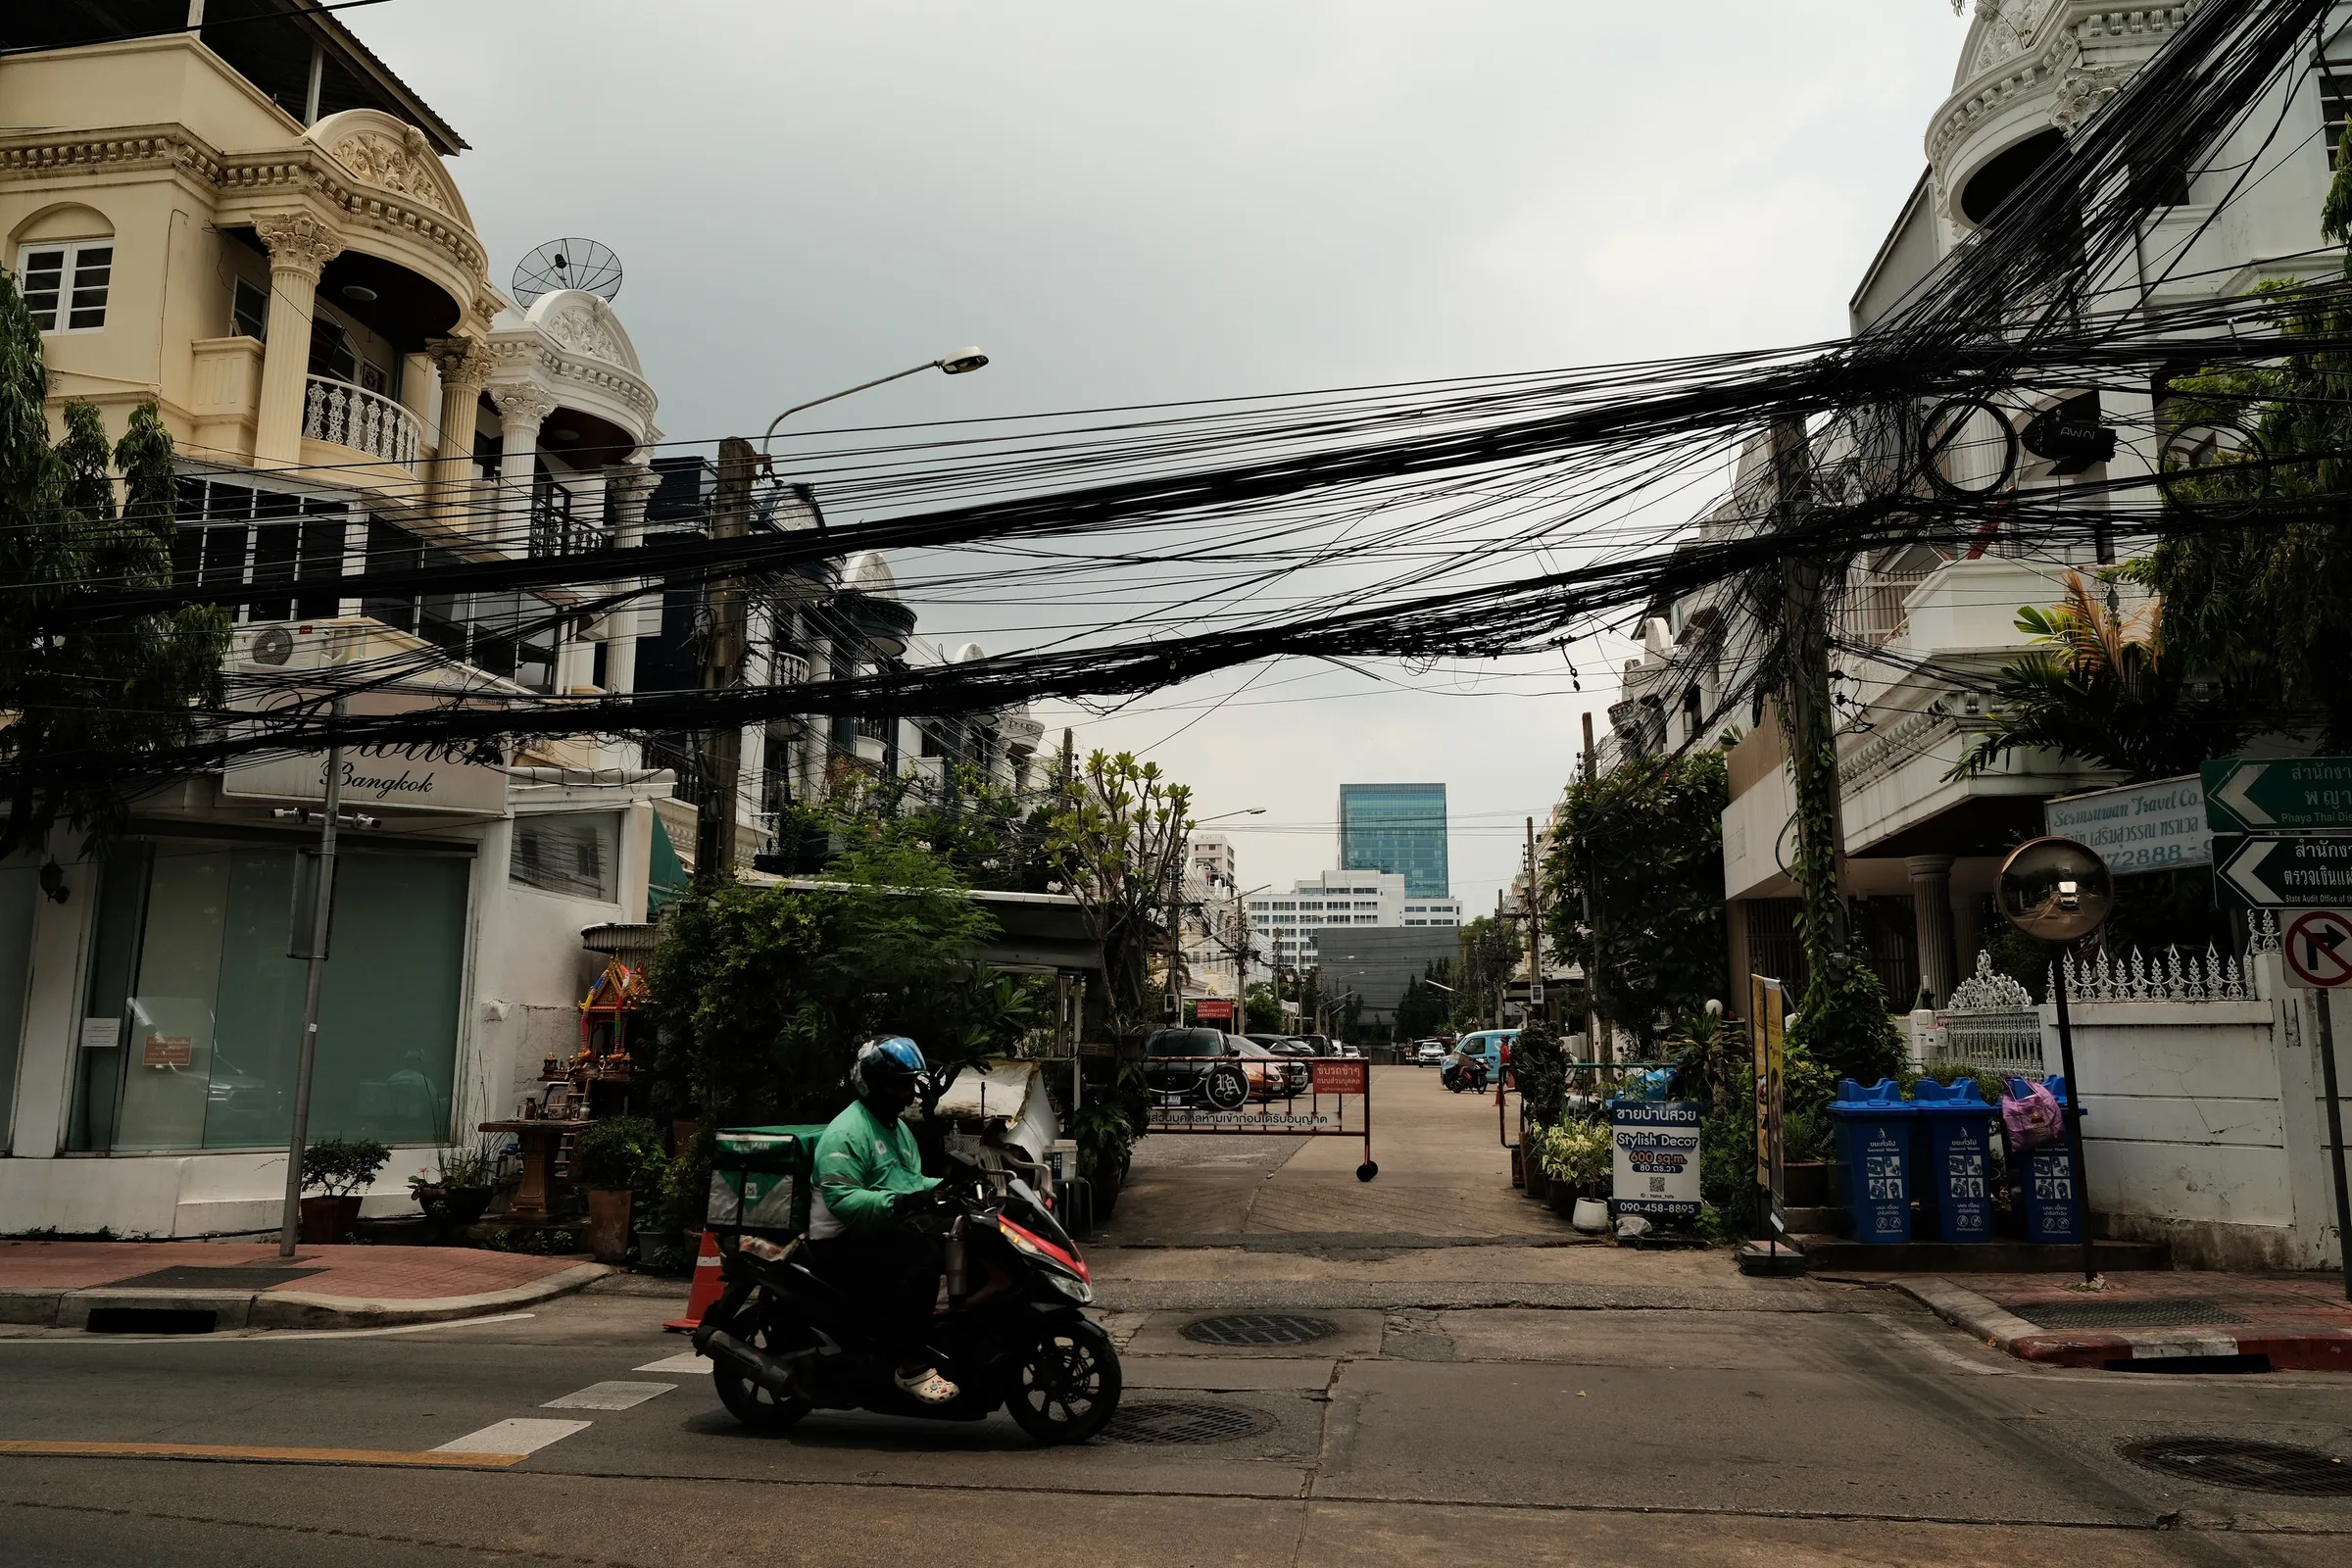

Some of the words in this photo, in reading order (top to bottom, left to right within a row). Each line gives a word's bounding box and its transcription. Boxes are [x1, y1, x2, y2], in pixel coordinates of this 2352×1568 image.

[2054, 804, 2129, 827] Sermsuwan
[2132, 791, 2177, 815] Travel
[2281, 812, 2312, 824] Phaya
[2314, 812, 2335, 822] Thai
[2302, 894, 2319, 903] Audit
[2320, 894, 2337, 903] Office
[2338, 894, 2346, 903] of
[1317, 1063, 1360, 1077] ขับรถช้าๆ
[1615, 1105, 1696, 1121] ขายบ้านสวย
[1617, 1133, 1656, 1150] Stylish
[1661, 1135, 1697, 1148] Decor
[1630, 1152, 1654, 1163] 600
[1656, 1153, 1688, 1165] sq.m.
[1620, 1202, 1695, 1214] 090-458-8895
